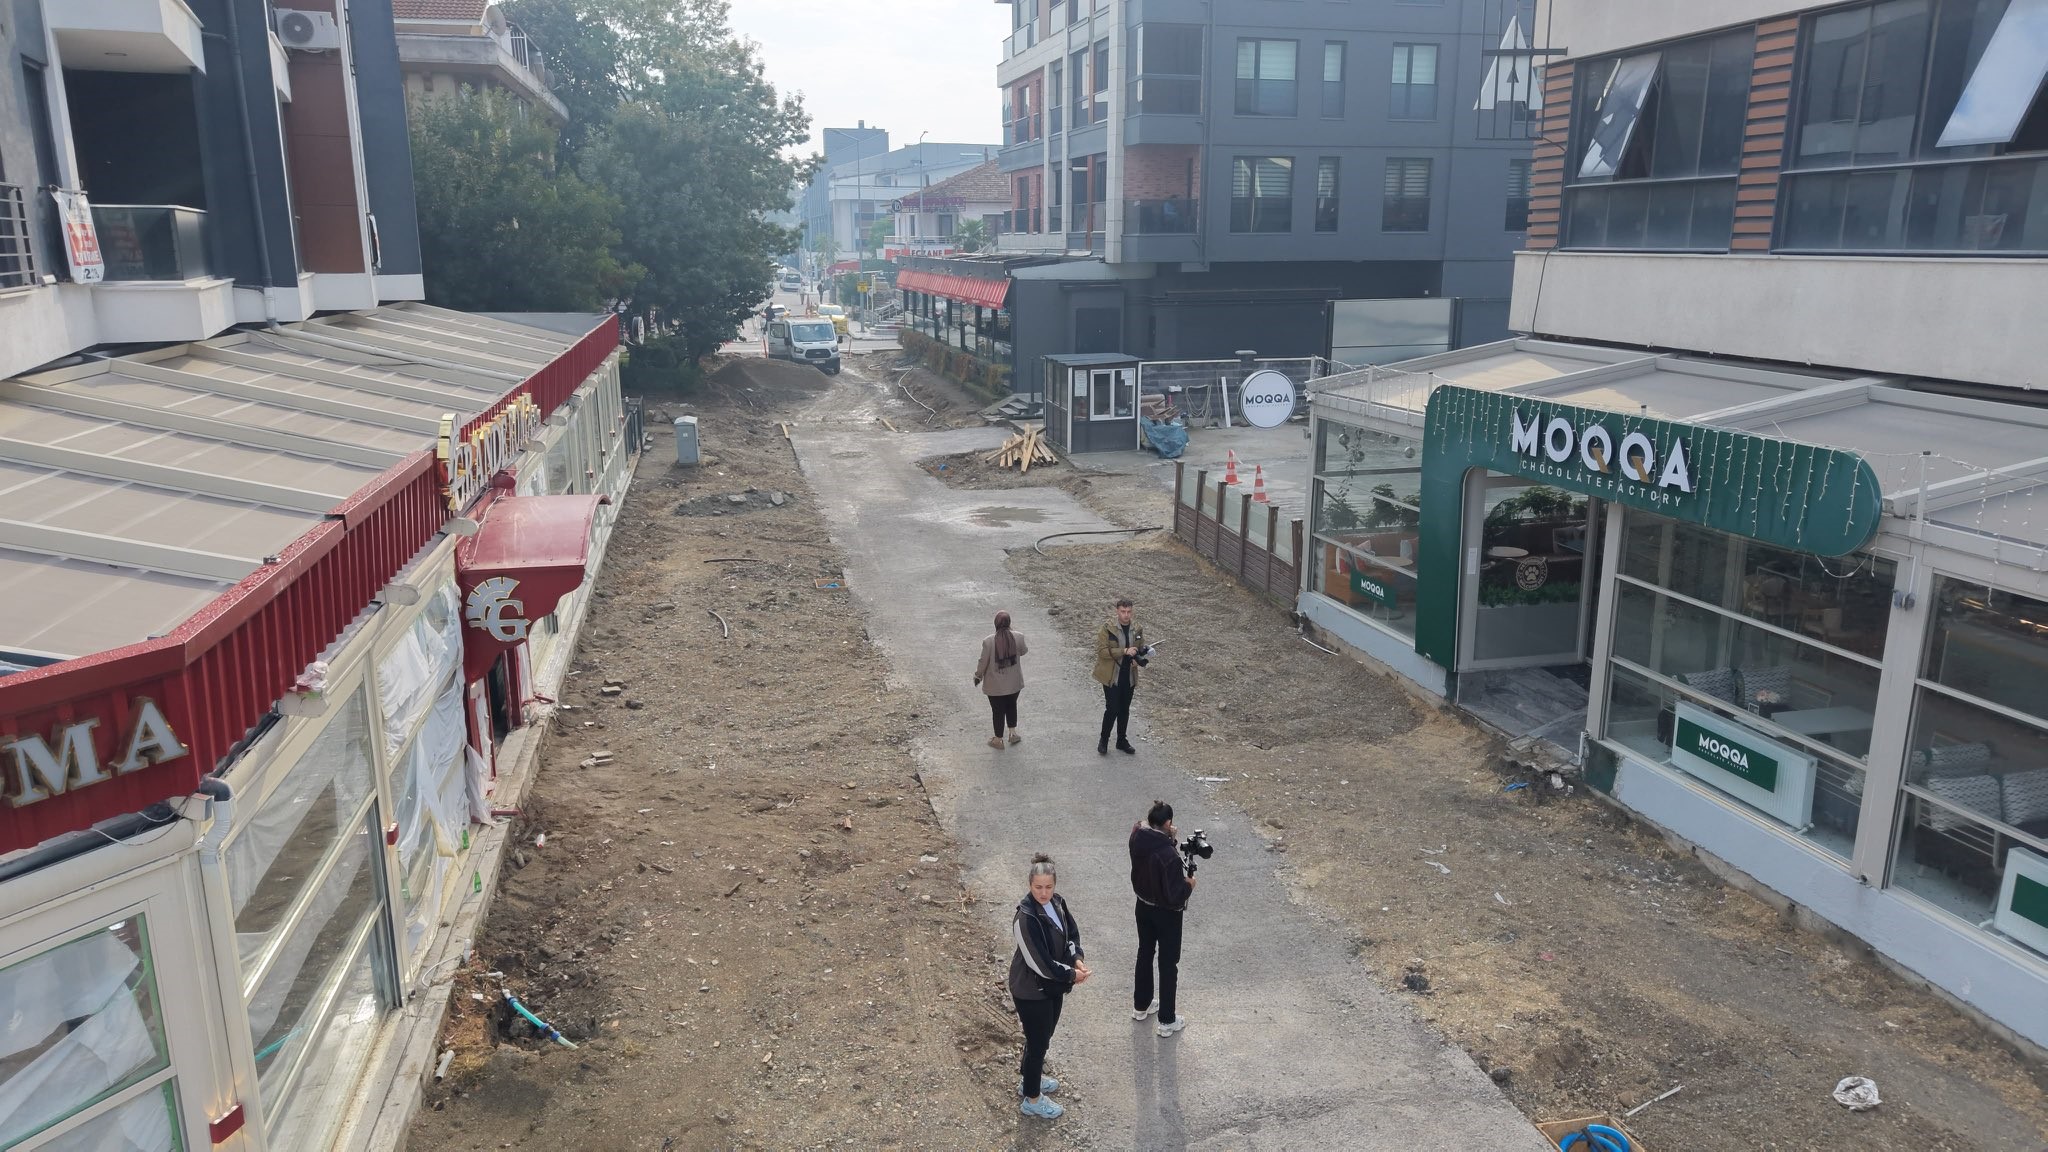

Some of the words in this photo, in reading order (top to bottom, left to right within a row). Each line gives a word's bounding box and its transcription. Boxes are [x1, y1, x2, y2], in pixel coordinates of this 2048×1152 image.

[1245, 393, 1290, 405] MOQQA
[1511, 408, 1691, 493] MOQQA
[1360, 578, 1385, 598] MOQQA
[0, 696, 190, 808] MA
[1698, 732, 1749, 769] MOQQA
